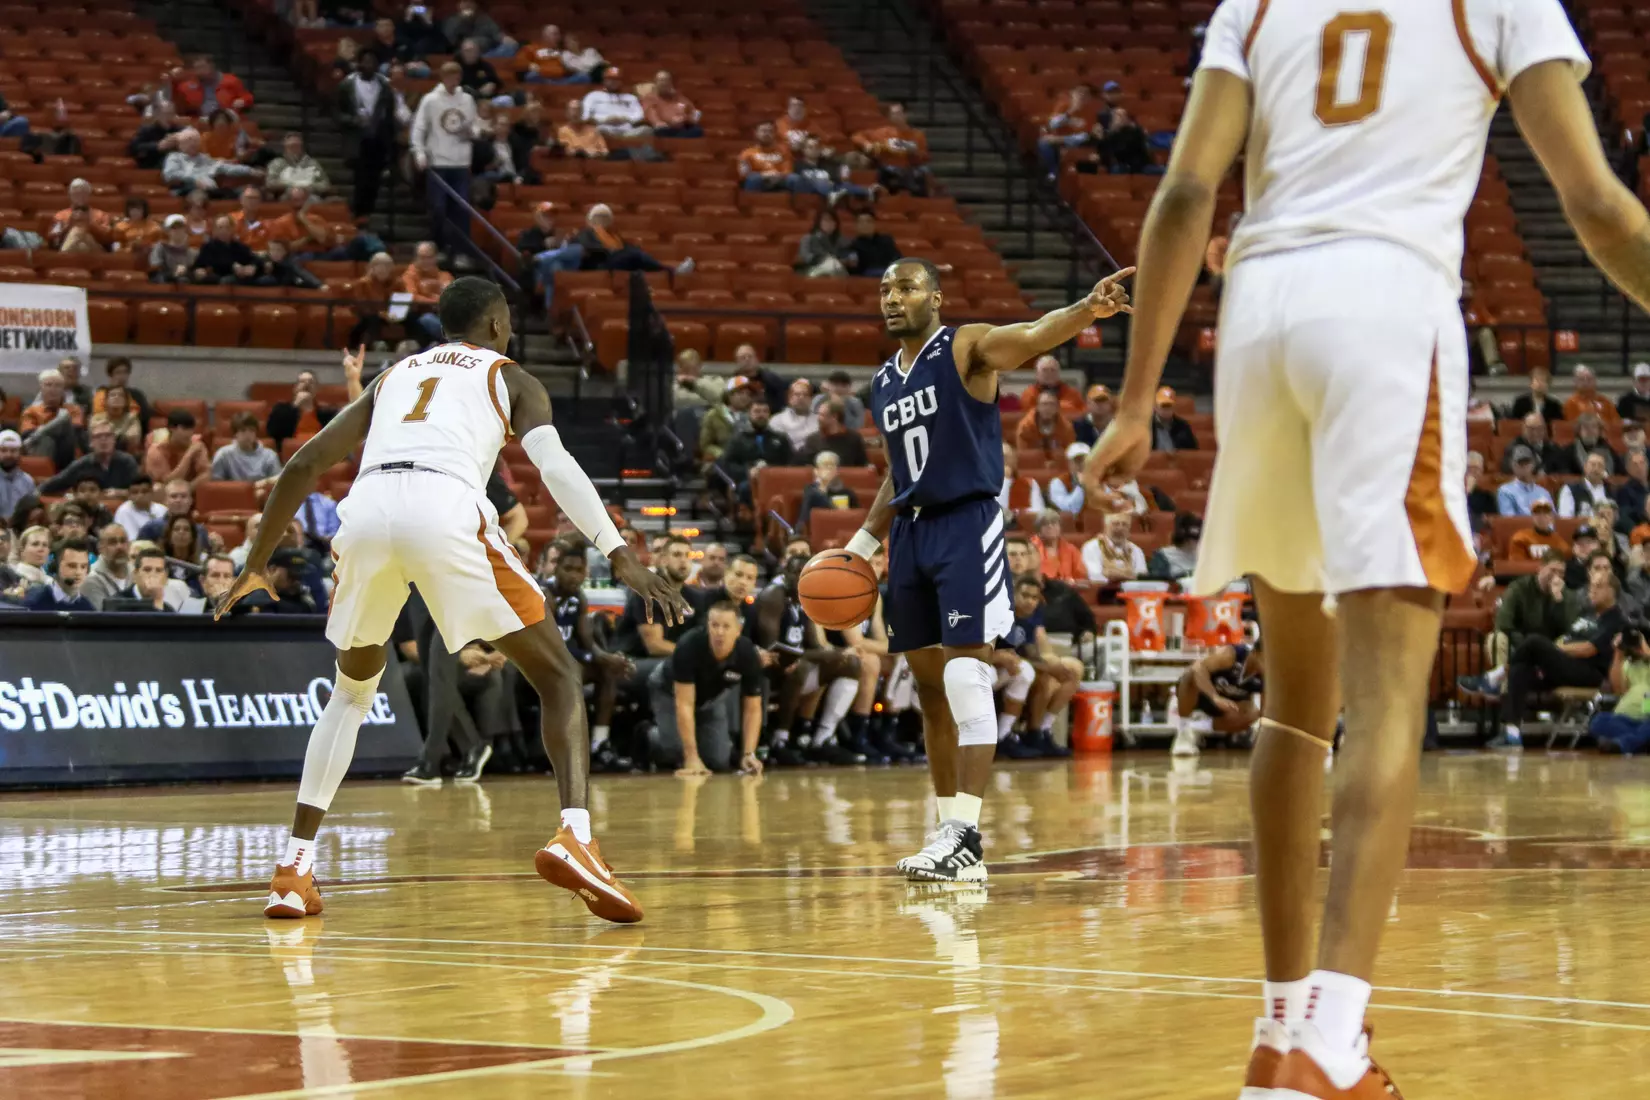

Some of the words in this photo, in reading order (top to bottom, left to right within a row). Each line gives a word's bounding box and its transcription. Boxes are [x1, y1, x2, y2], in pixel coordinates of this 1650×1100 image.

[1312, 9, 1396, 128] 0
[426, 351, 483, 370] JONES
[400, 376, 443, 423] 1
[882, 385, 938, 432] CBU
[904, 425, 930, 482] 0
